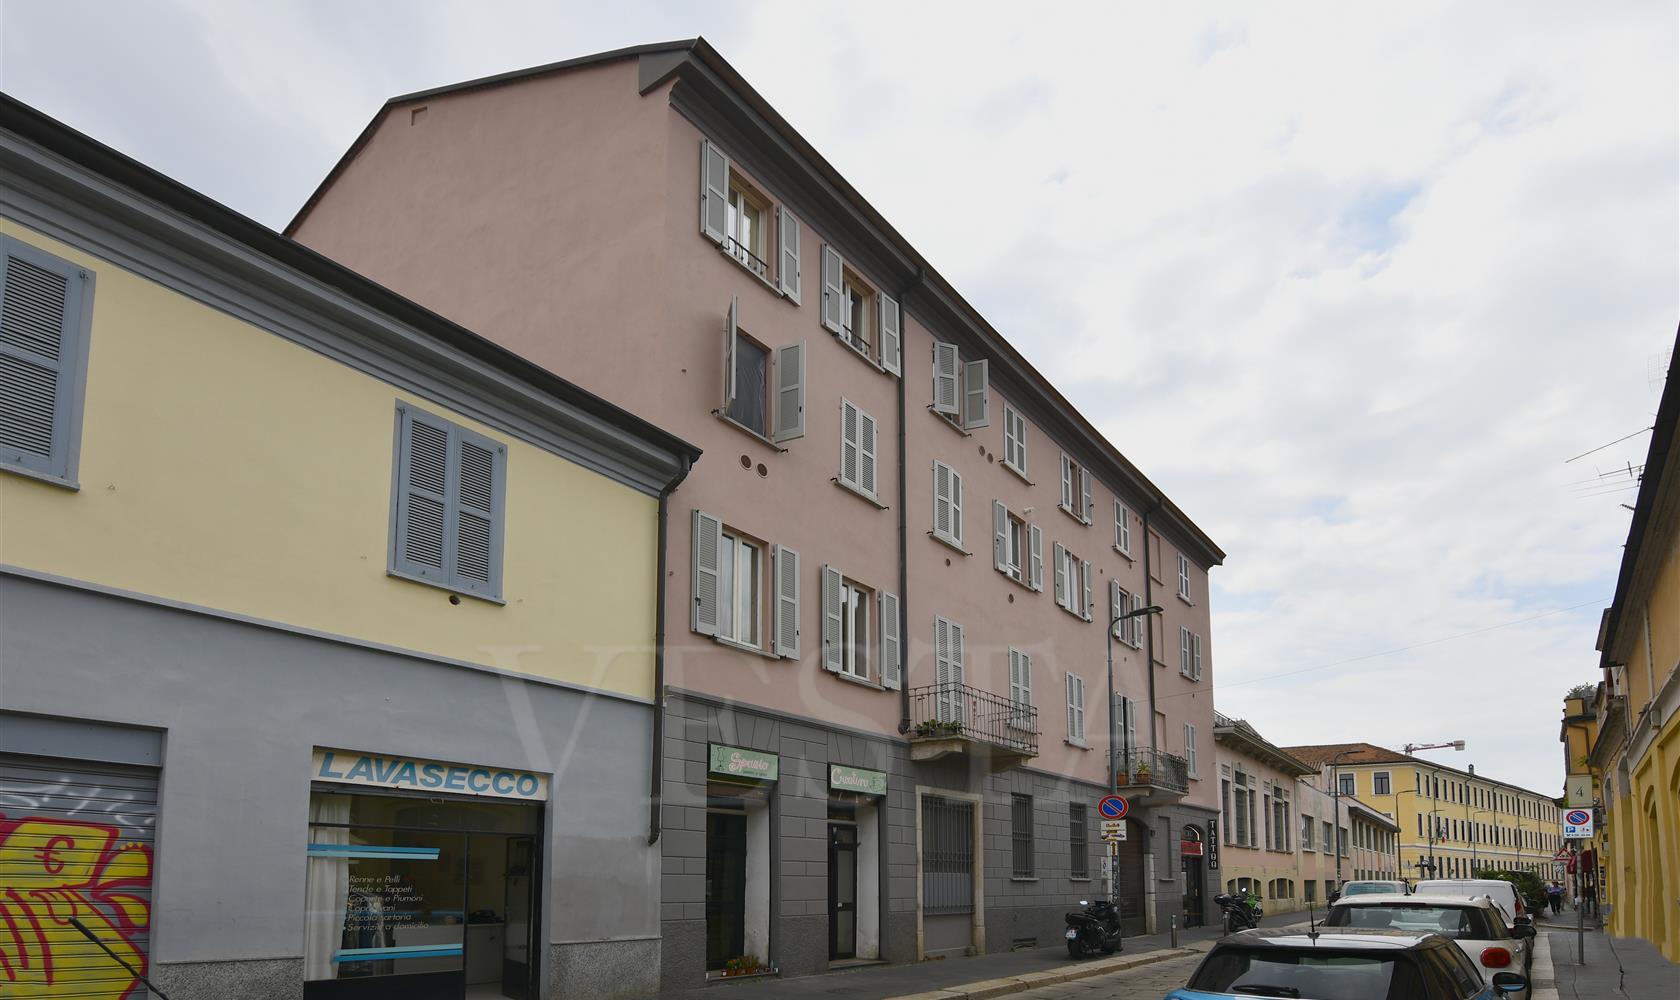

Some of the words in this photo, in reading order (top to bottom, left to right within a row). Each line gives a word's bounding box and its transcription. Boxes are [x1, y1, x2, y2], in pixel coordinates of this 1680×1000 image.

[318, 751, 540, 797] LAVASECCO
[1575, 785, 1584, 797] 4
[1209, 820, 1218, 868] TATTOO
[349, 875, 374, 883] Renne
[384, 875, 401, 883] Pelli
[349, 884, 374, 893] Tende
[384, 884, 413, 894] Tappeti
[393, 894, 424, 902] Piumoni
[347, 913, 378, 922] Piccola
